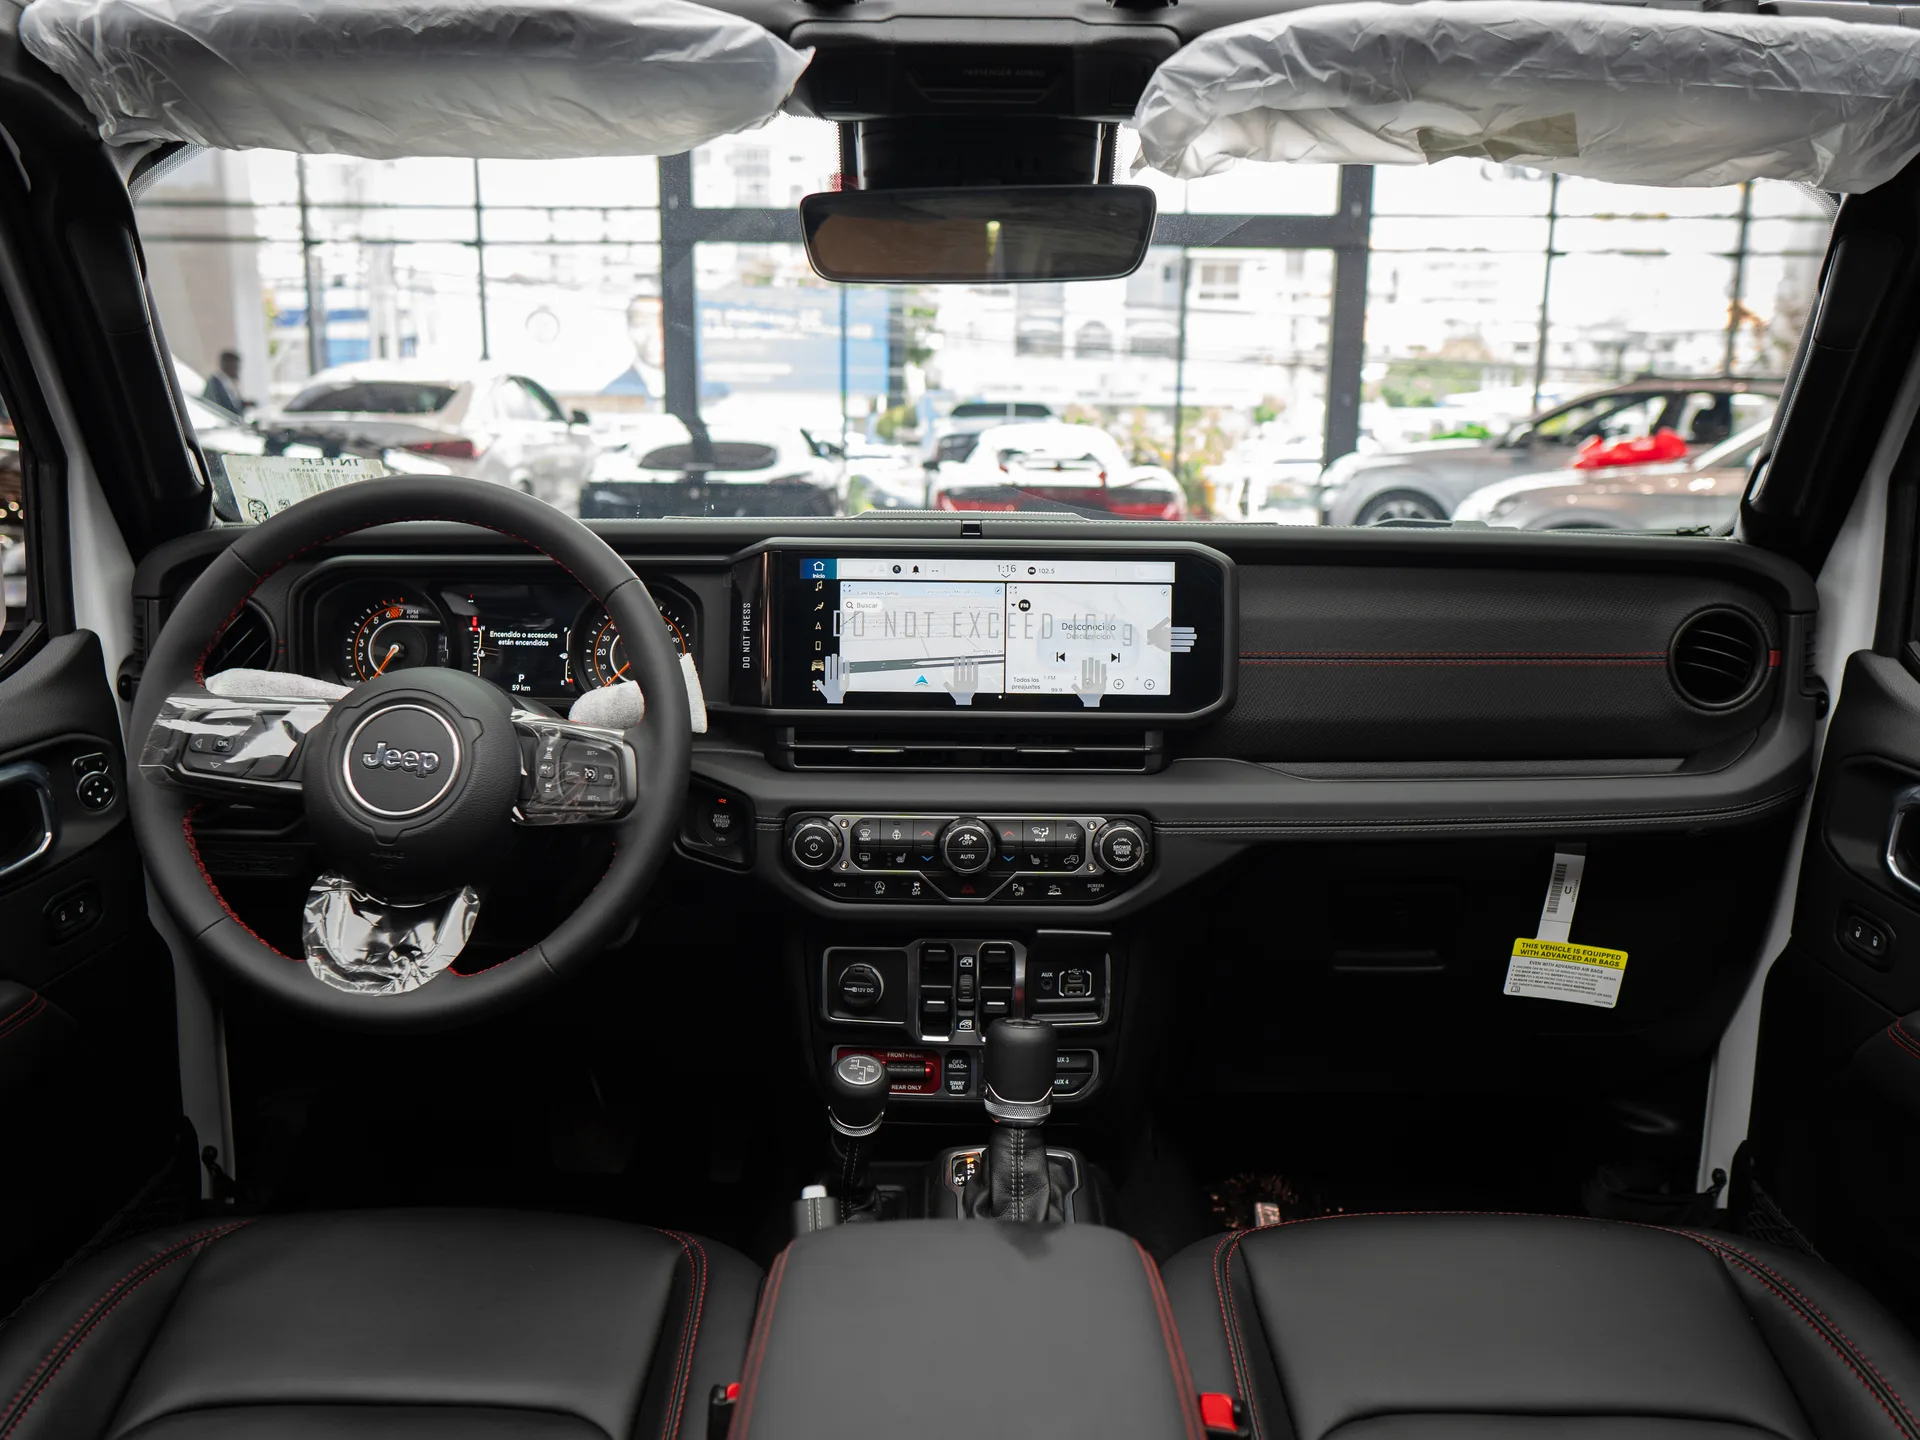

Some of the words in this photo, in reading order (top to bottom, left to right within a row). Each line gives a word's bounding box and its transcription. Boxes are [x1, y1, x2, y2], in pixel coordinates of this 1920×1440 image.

[997, 564, 1016, 573] 1:16
[373, 617, 379, 625] 5
[742, 602, 751, 632] PRESS
[833, 610, 865, 637] DO
[885, 611, 934, 638] NOT
[953, 611, 1053, 640] EXCEED
[363, 627, 369, 635] 4
[527, 631, 558, 639] accesorios
[359, 639, 364, 647] 3
[498, 638, 514, 646] están
[515, 638, 549, 647] encendidos
[742, 633, 751, 653] NOT
[742, 655, 751, 669] DO
[518, 674, 525, 683] P
[362, 742, 440, 778] Jeep
[1564, 886, 1572, 895] U
[1541, 945, 1571, 953] VEHICLE
[1583, 950, 1621, 960] EQUIPPED
[1541, 952, 1582, 961] ADVANCED
